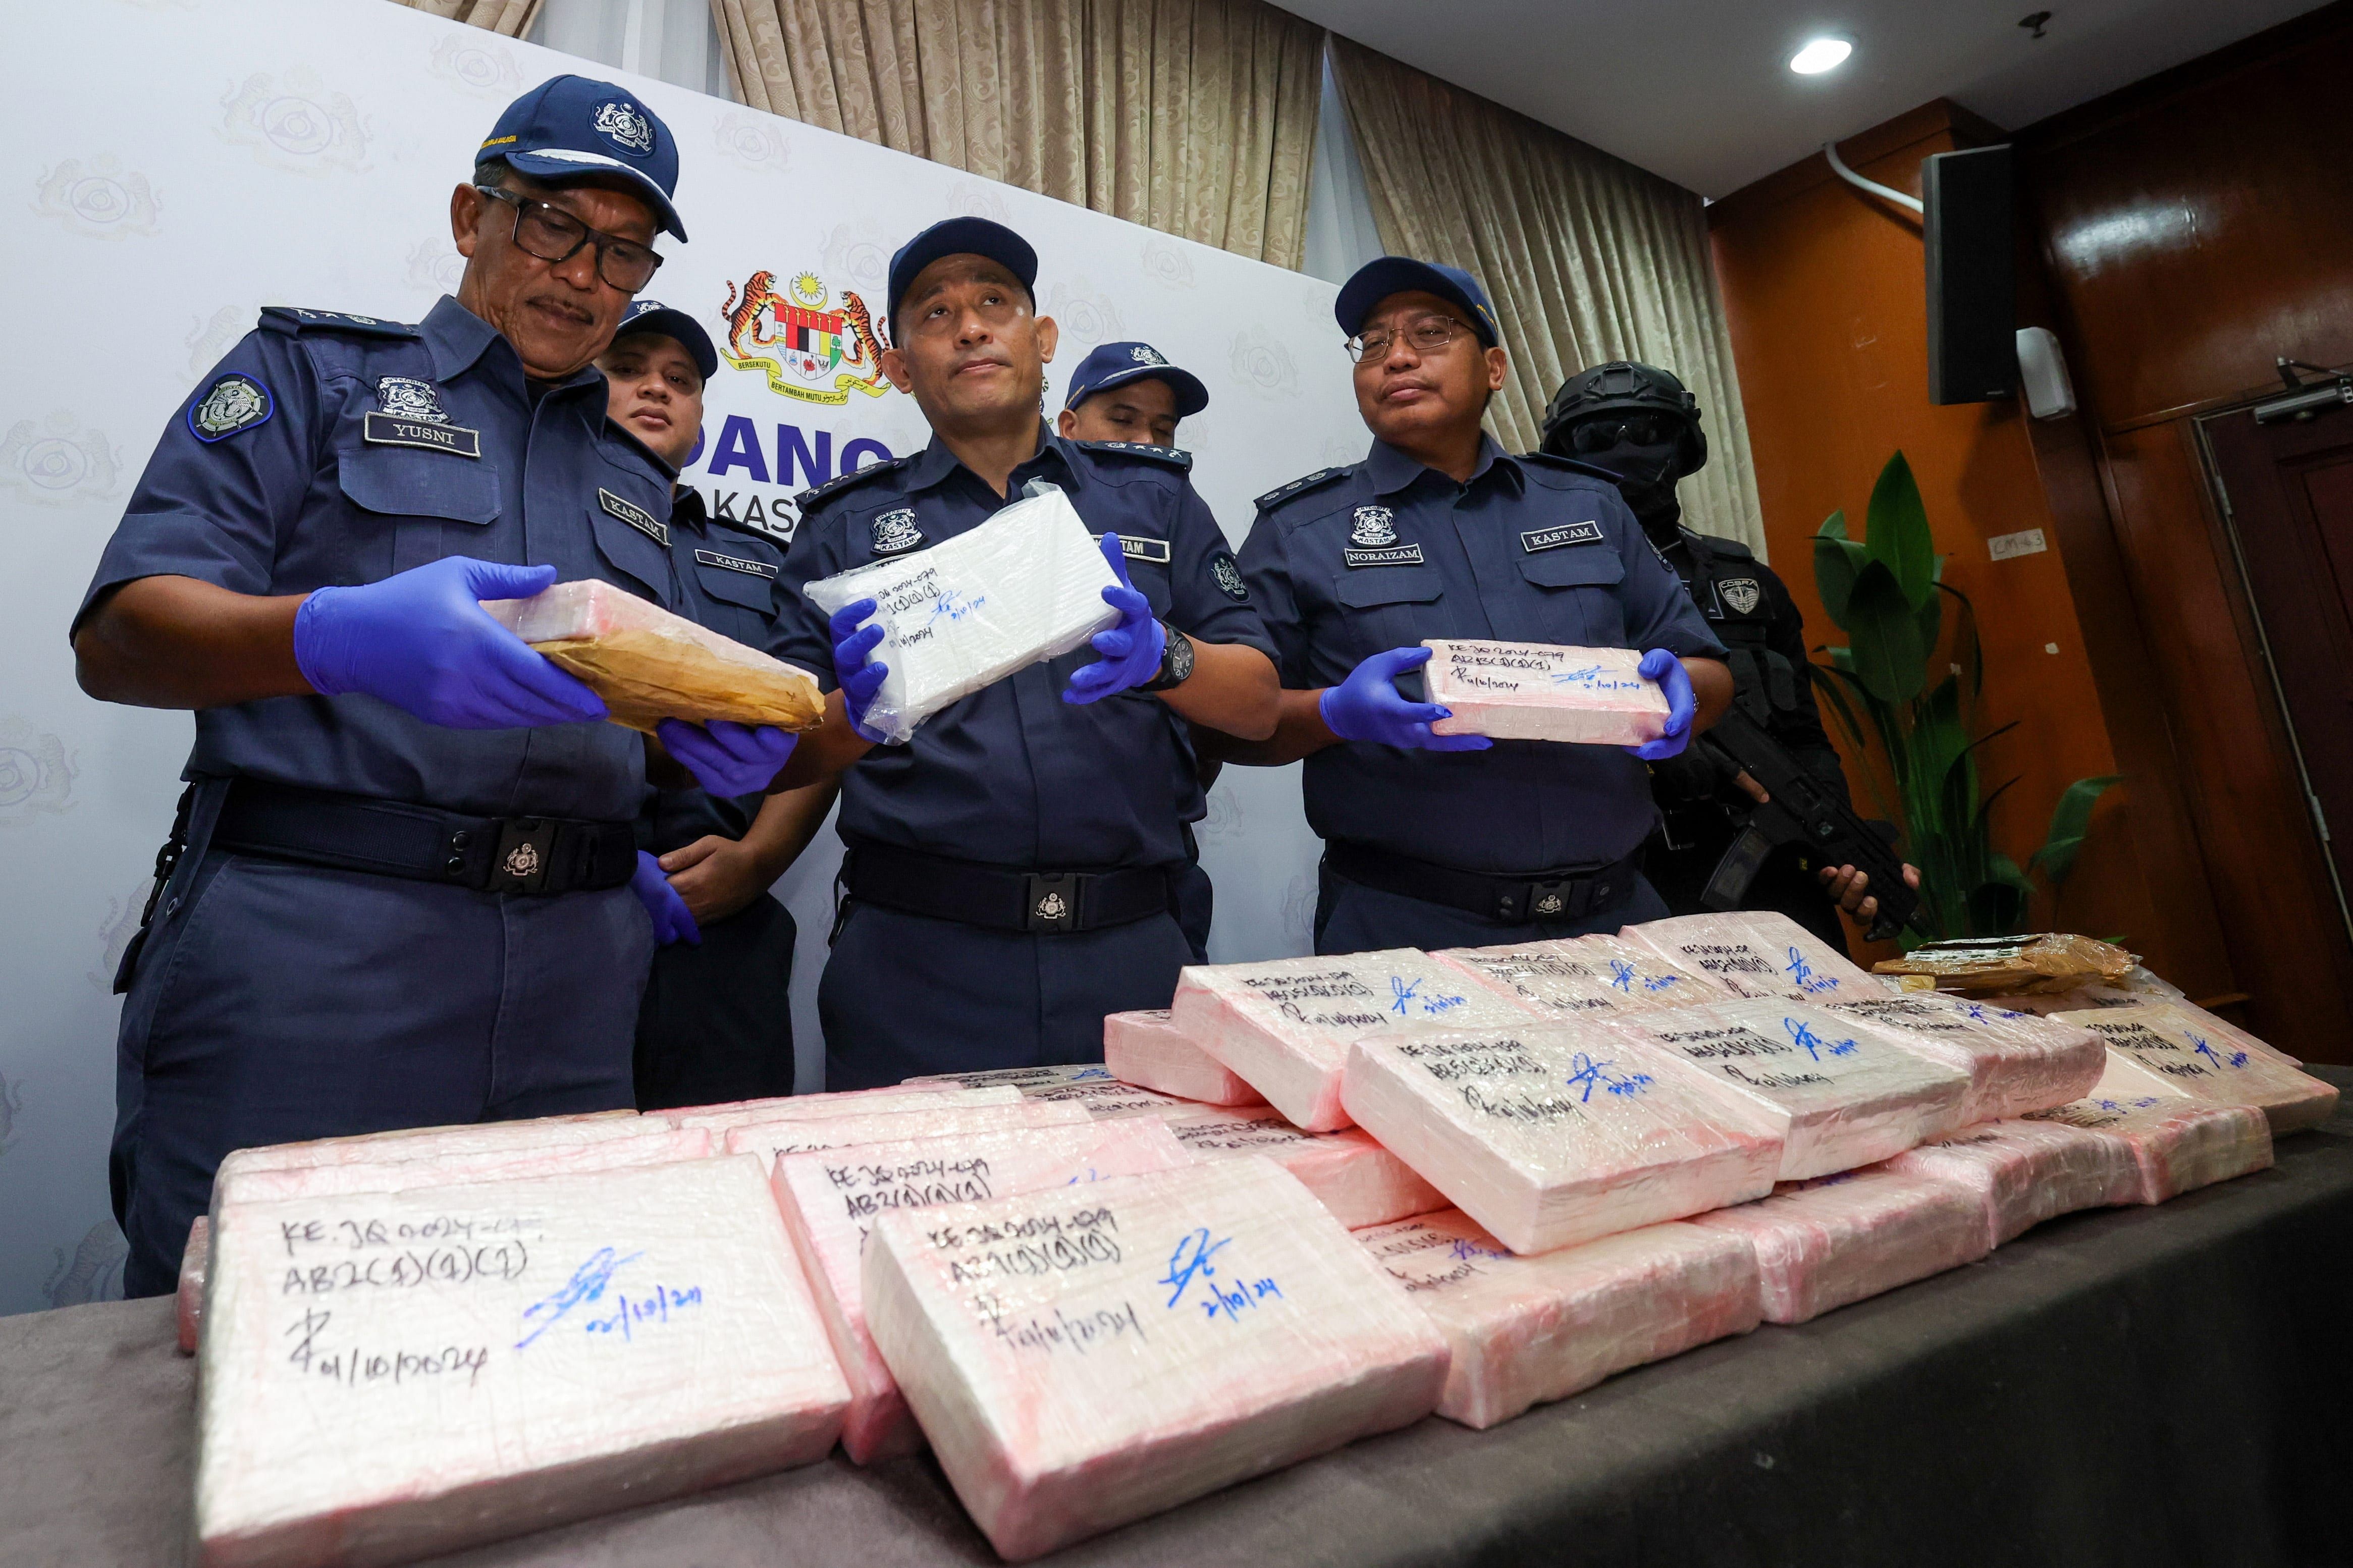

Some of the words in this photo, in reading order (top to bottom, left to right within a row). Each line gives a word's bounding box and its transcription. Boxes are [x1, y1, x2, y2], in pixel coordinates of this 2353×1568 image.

[738, 361, 771, 369] BERSEKUTU
[771, 382, 805, 399] BERTAMBAH
[806, 393, 822, 401] MUTU
[393, 423, 455, 445] YUSNI
[609, 499, 661, 537] KASTAM
[714, 489, 795, 533] KAS
[881, 537, 916, 550] KASTAM
[1531, 527, 1592, 546] KASTAM
[1095, 539, 1144, 554] KTAM
[1348, 550, 1420, 561] NORAIZAM
[715, 556, 763, 573] KASTAM
[1721, 580, 1757, 588] COBRA
[1201, 1278, 1282, 1323] 2/10/24
